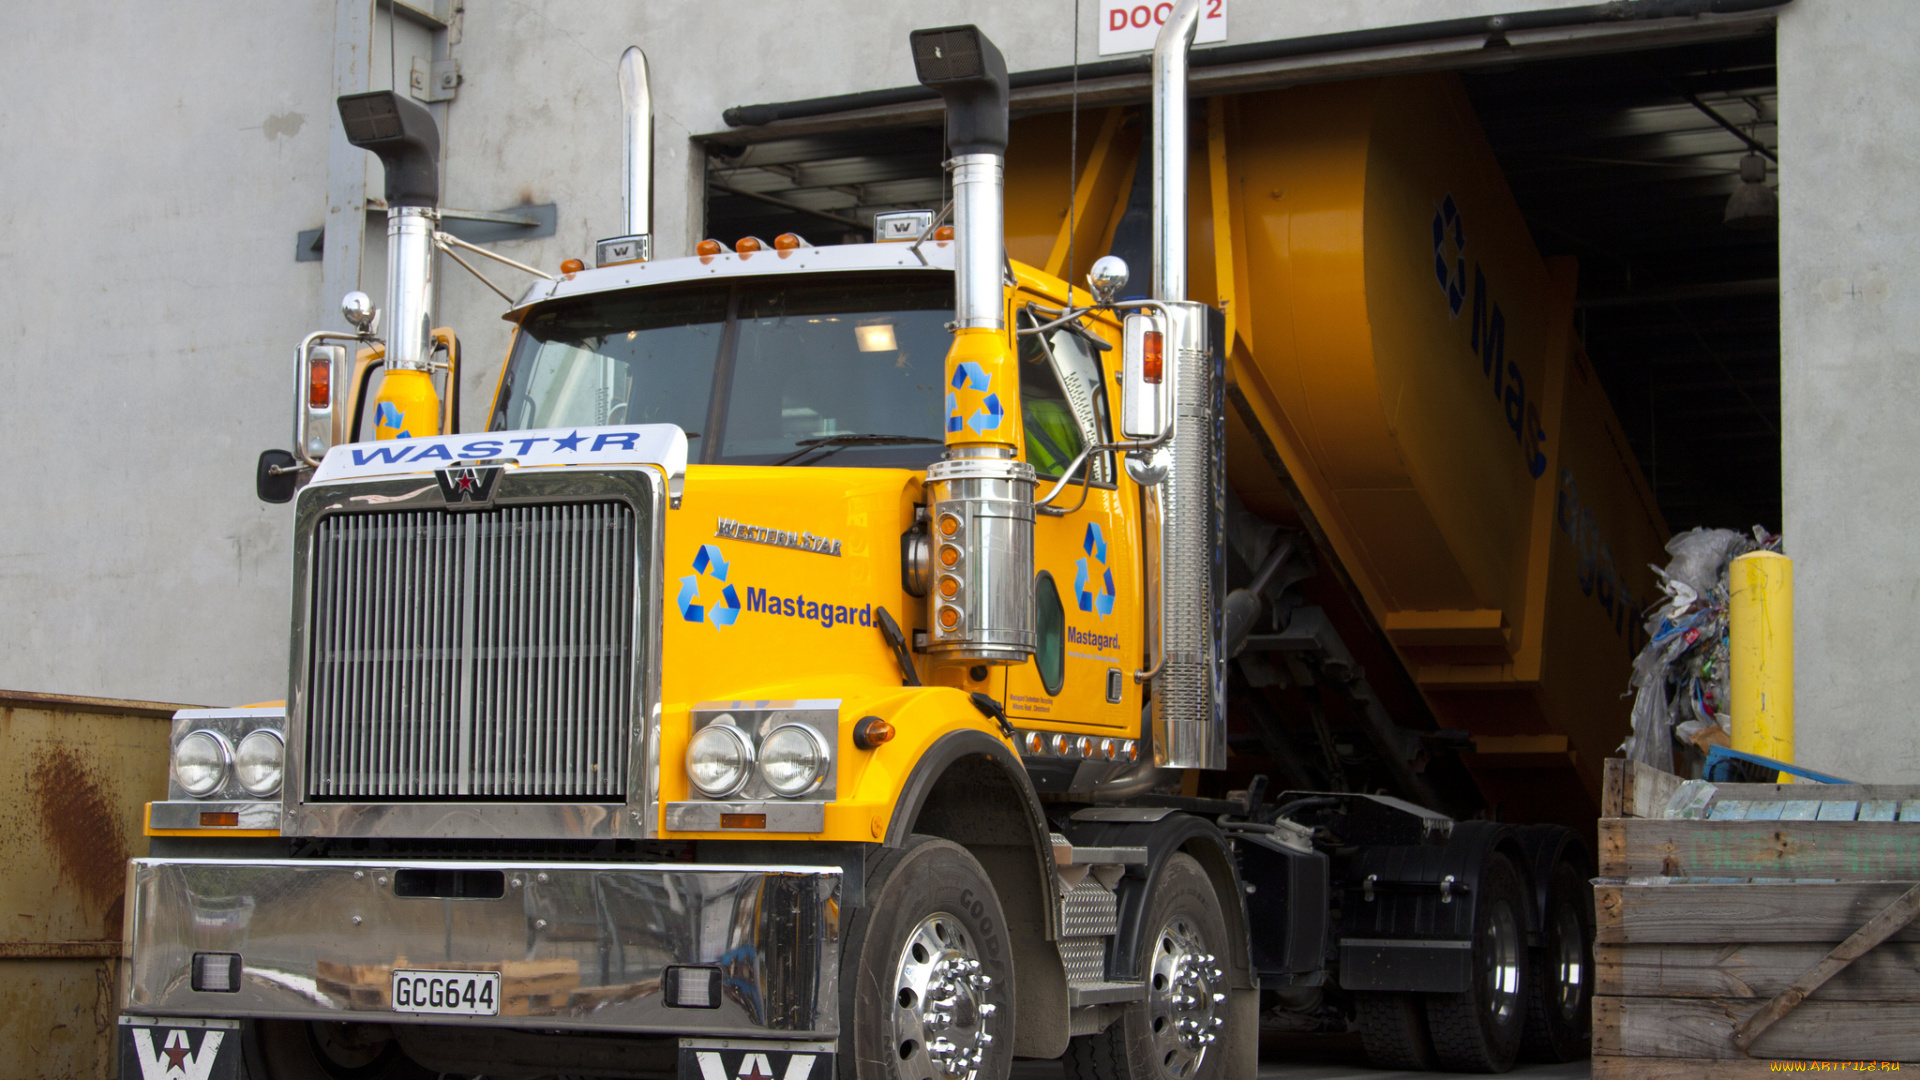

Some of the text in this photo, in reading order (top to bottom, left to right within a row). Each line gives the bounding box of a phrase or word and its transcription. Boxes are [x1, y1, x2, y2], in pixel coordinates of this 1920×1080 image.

[1109, 0, 1223, 32] DOO 2
[396, 977, 494, 1009] GCG644
